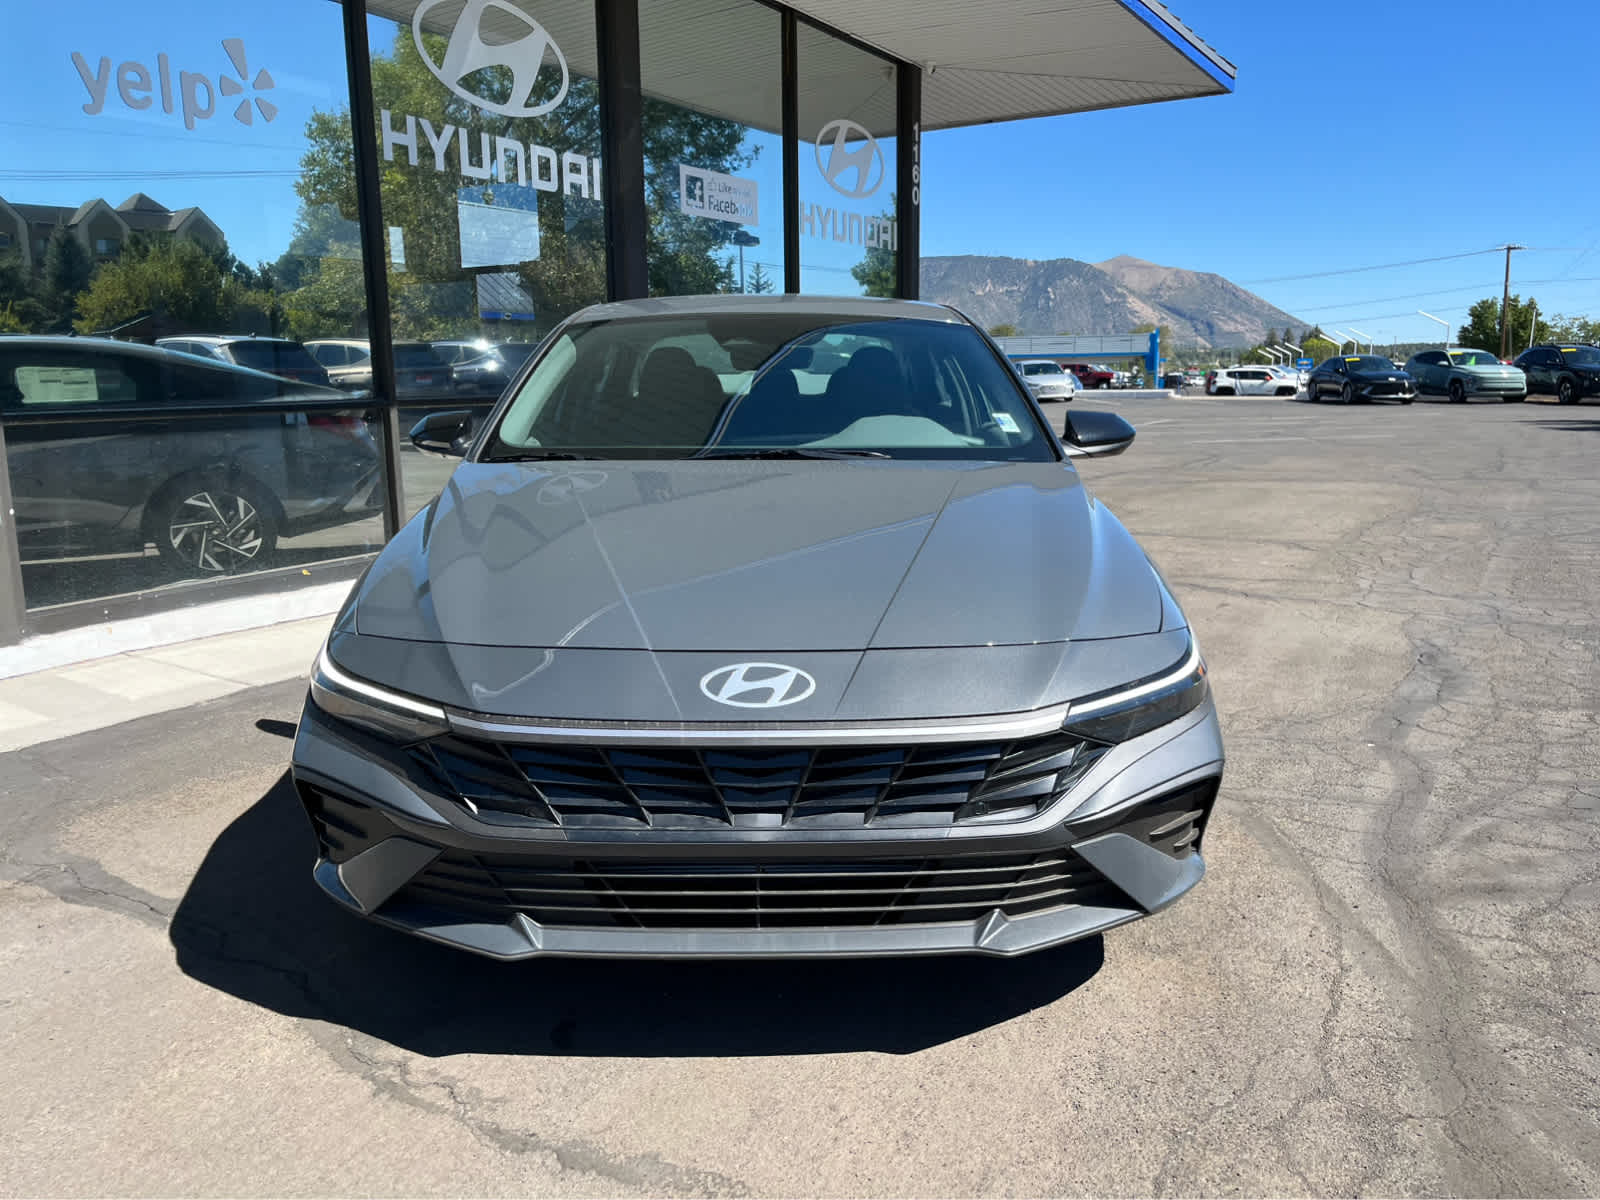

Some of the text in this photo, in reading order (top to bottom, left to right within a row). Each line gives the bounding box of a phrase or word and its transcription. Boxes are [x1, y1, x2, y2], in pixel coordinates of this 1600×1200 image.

[71, 51, 215, 130] yelp
[380, 109, 601, 201] HYUNDAI
[911, 121, 920, 206] 1160
[799, 200, 898, 251] HYUNDAI
